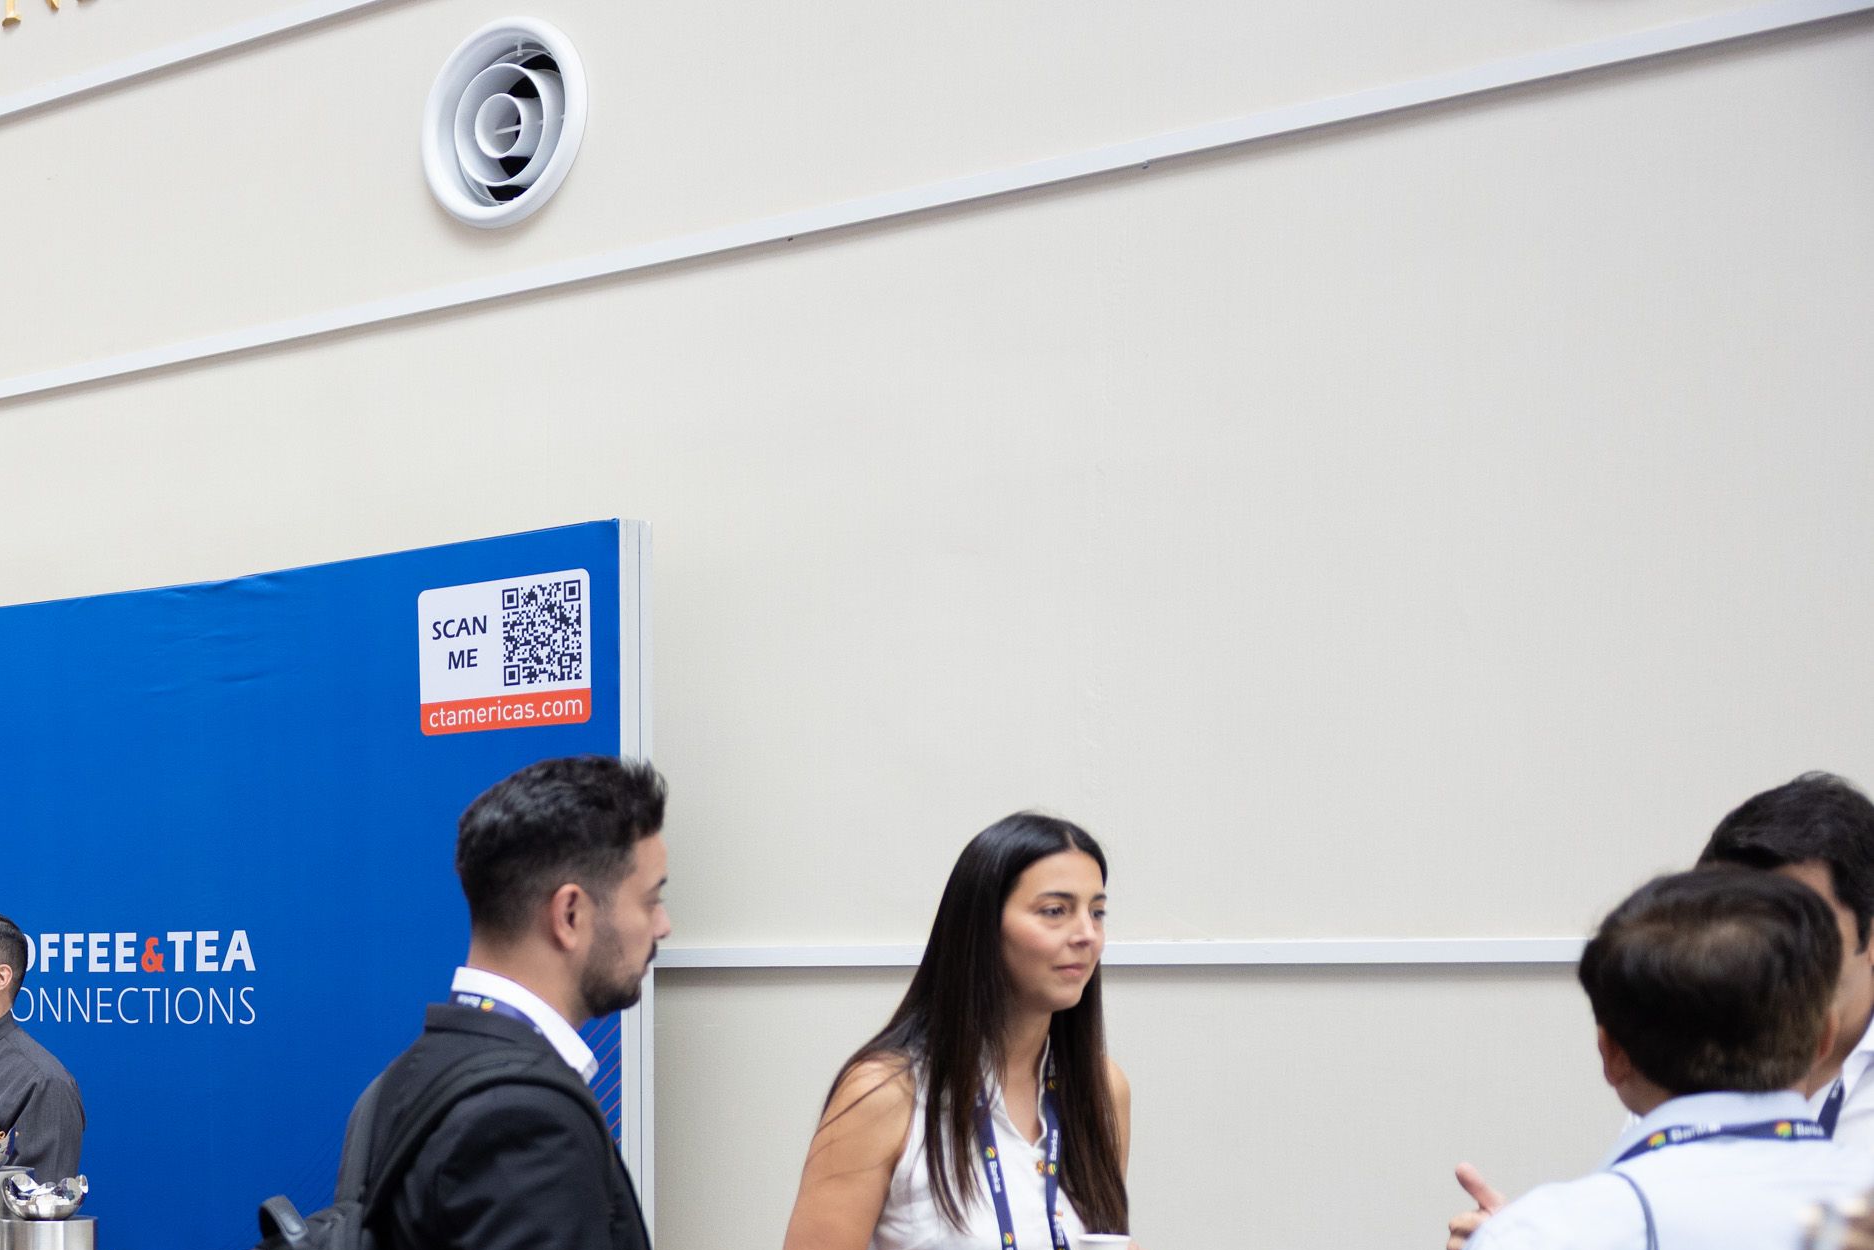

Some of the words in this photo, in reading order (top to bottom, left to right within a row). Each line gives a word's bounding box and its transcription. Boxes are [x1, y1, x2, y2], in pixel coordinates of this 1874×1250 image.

[432, 615, 487, 640] SCAN
[448, 648, 478, 670] ME
[429, 698, 583, 728] ctamericas.com
[10, 986, 256, 1025] ONNECTIONS
